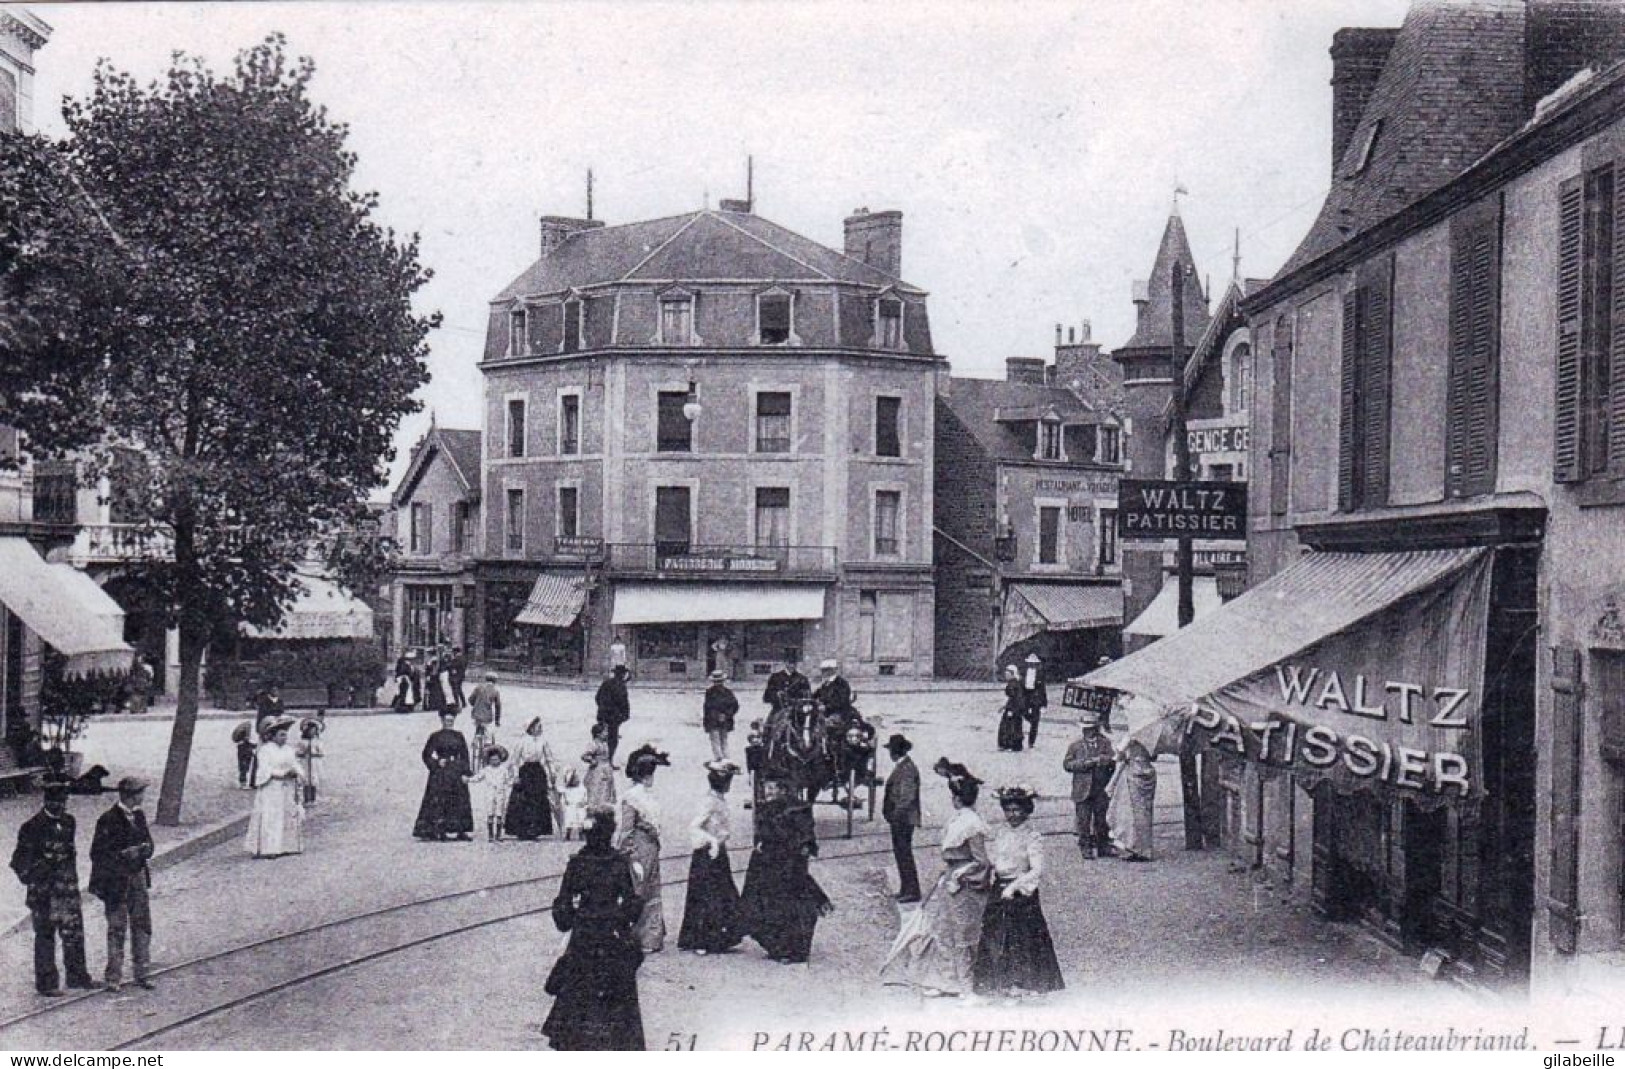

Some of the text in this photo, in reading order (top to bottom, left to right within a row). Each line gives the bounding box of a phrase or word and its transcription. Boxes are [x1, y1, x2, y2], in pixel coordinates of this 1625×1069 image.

[1142, 489, 1225, 510] WALTZ
[1127, 513, 1237, 530] PATISSIER
[1276, 664, 1470, 728] WALTZ
[1187, 702, 1469, 797] PATISSIER
